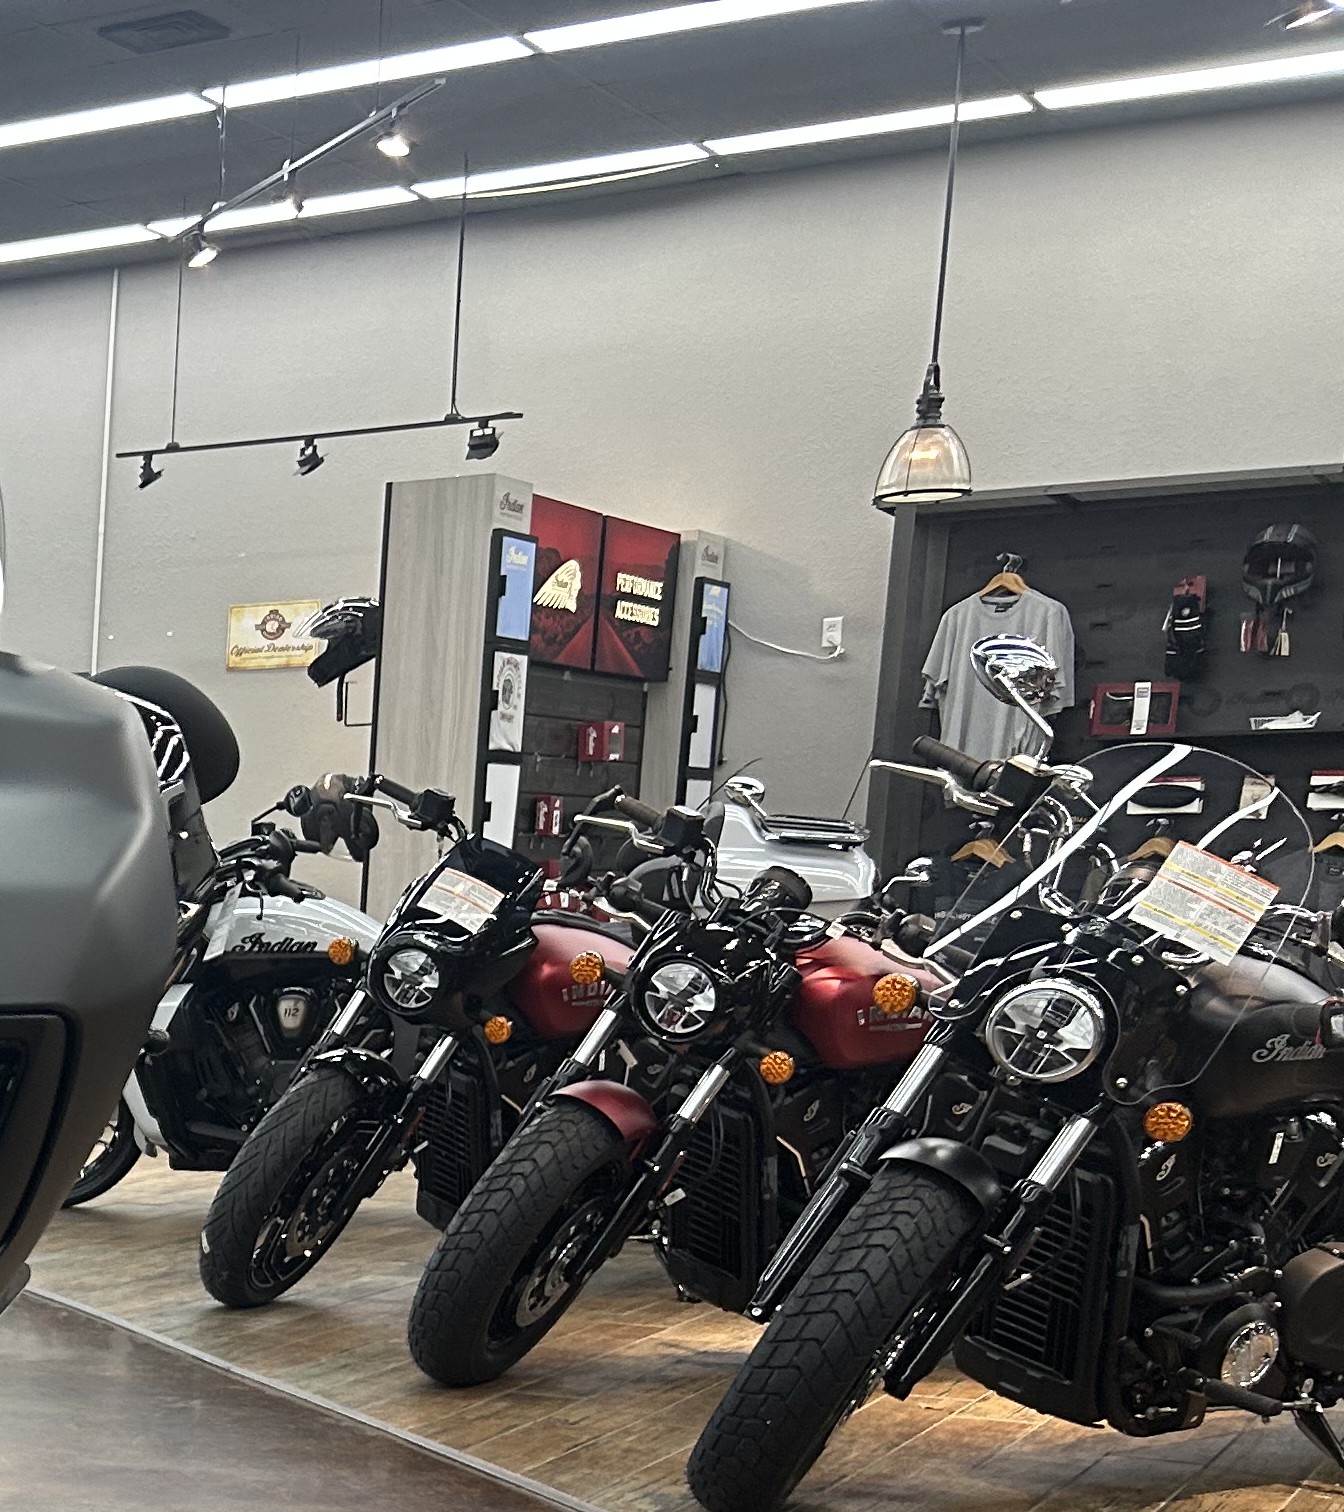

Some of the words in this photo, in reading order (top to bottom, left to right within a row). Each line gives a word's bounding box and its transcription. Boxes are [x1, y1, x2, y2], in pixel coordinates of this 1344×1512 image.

[232, 932, 318, 954] Indian
[284, 1007, 300, 1018] 112
[1251, 1033, 1327, 1063] Indian
